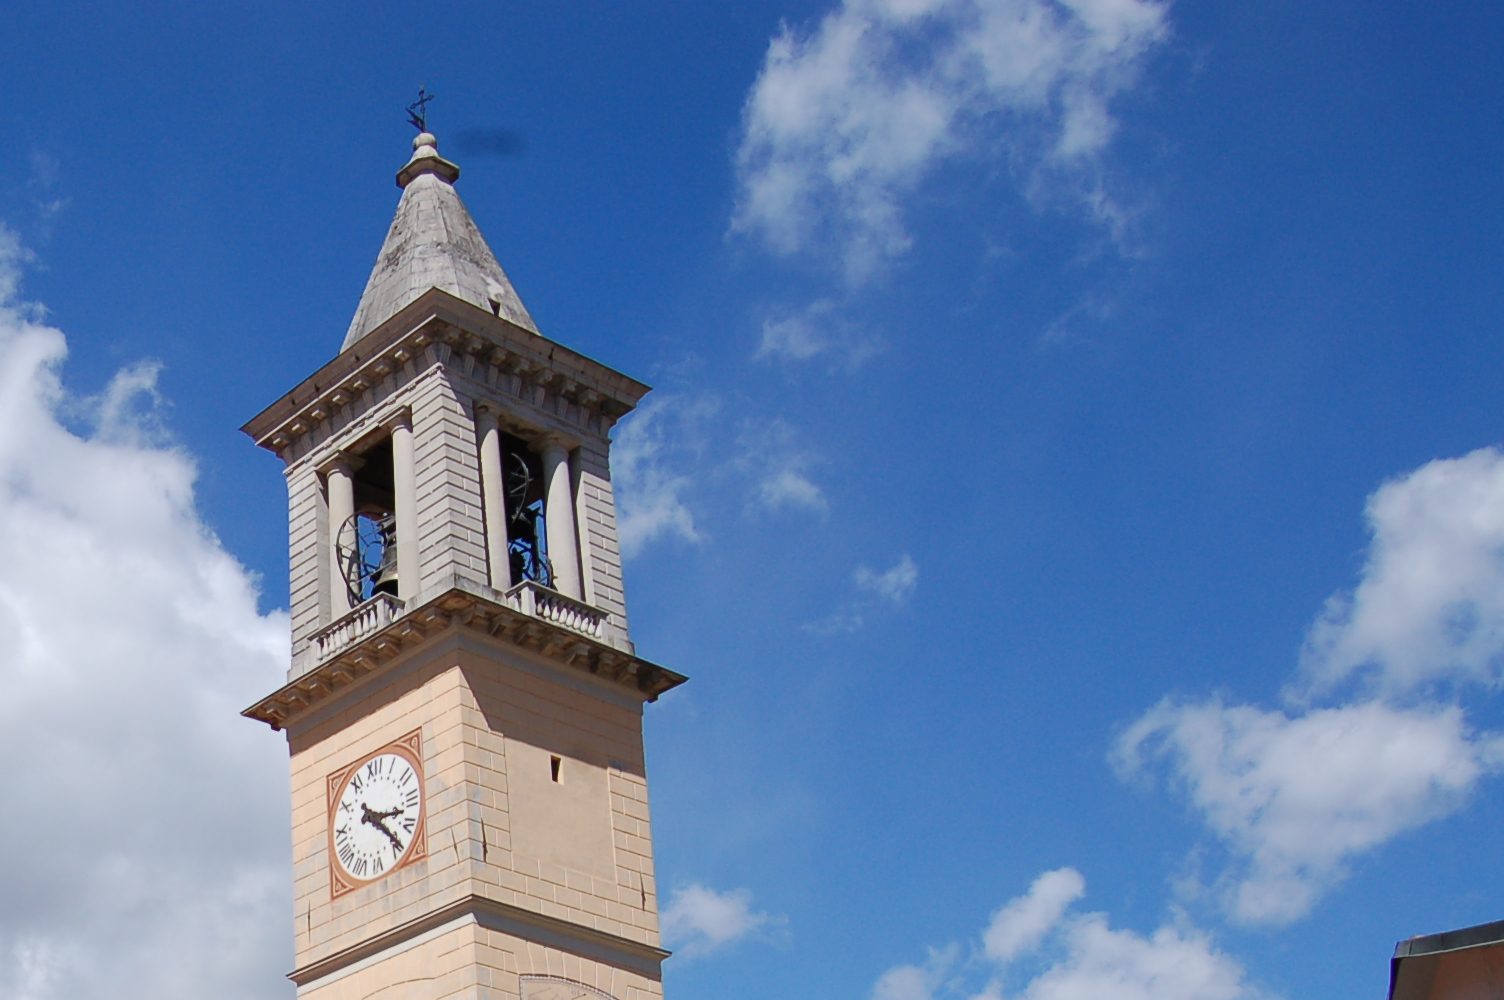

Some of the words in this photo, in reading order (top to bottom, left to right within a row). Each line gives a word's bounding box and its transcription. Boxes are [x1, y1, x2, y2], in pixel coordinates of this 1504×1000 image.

[367, 757, 382, 780] XII
[389, 757, 396, 774] I
[350, 773, 363, 795] XI
[400, 767, 413, 786] II
[339, 800, 352, 813] X
[406, 788, 418, 807] III
[336, 823, 347, 846] IX
[403, 818, 416, 834] IV
[338, 843, 354, 869] VIII
[373, 856, 383, 875] VI
[352, 857, 367, 877] VII
